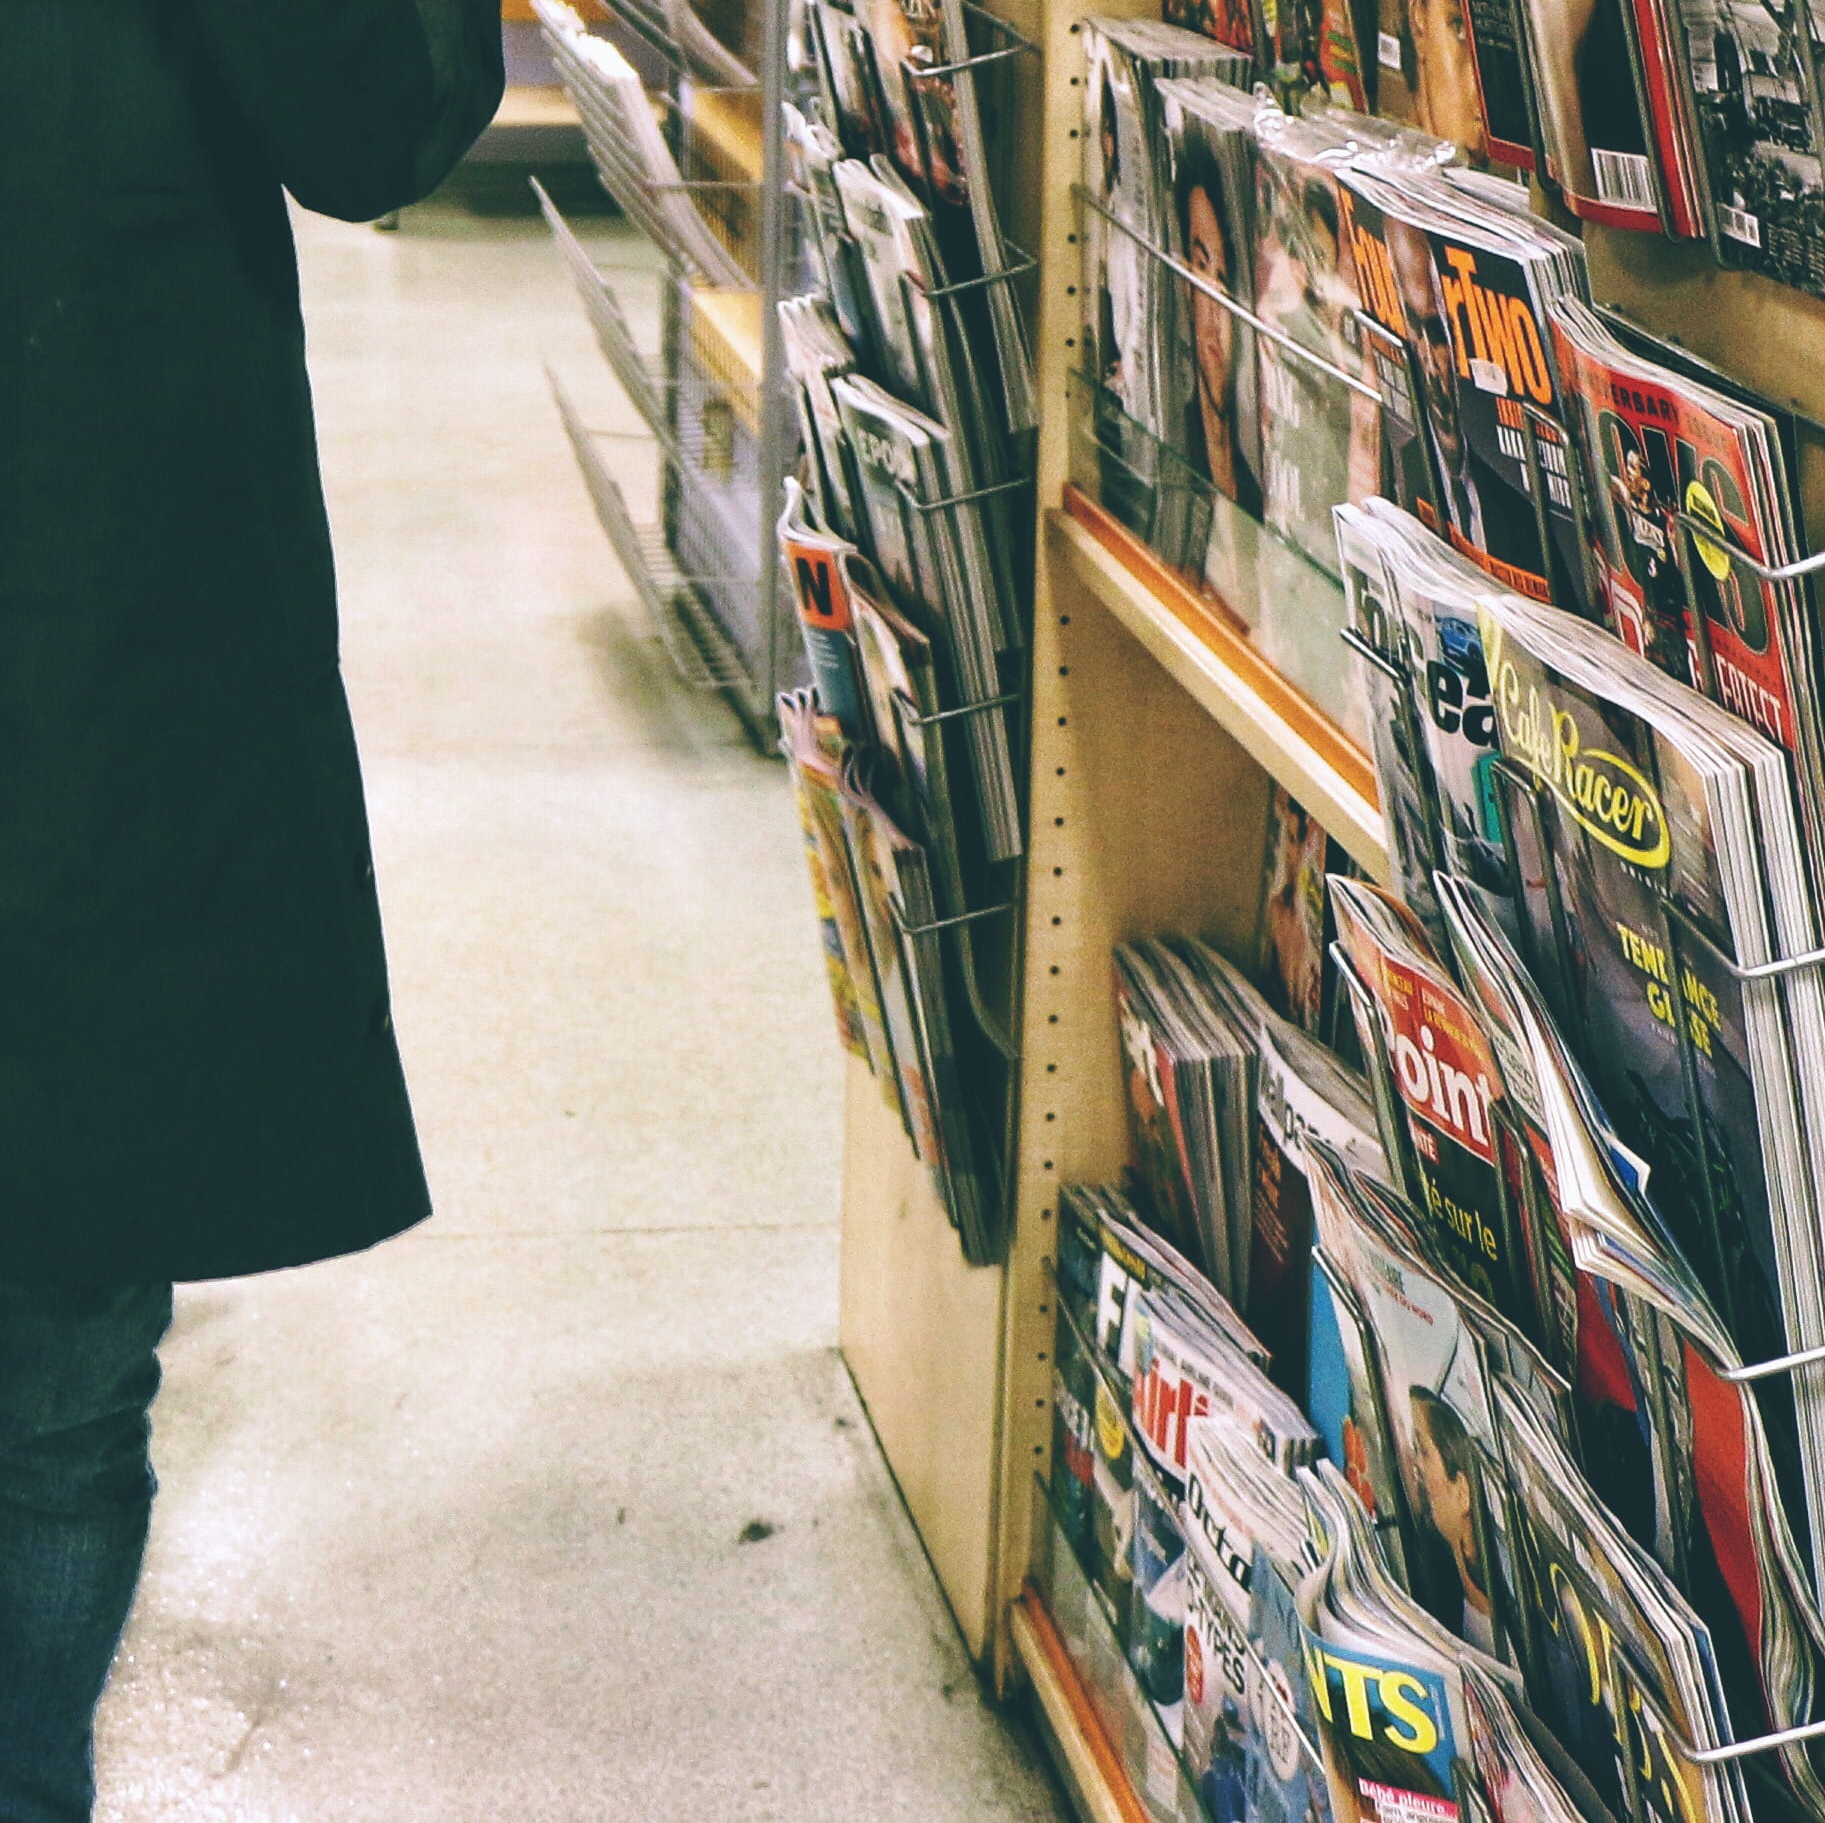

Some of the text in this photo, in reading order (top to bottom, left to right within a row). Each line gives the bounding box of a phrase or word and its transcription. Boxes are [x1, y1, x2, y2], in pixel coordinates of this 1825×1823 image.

[1548, 701, 1654, 841] Racer
[1444, 1195, 1473, 1245] sur
[1474, 1208, 1499, 1262] le
